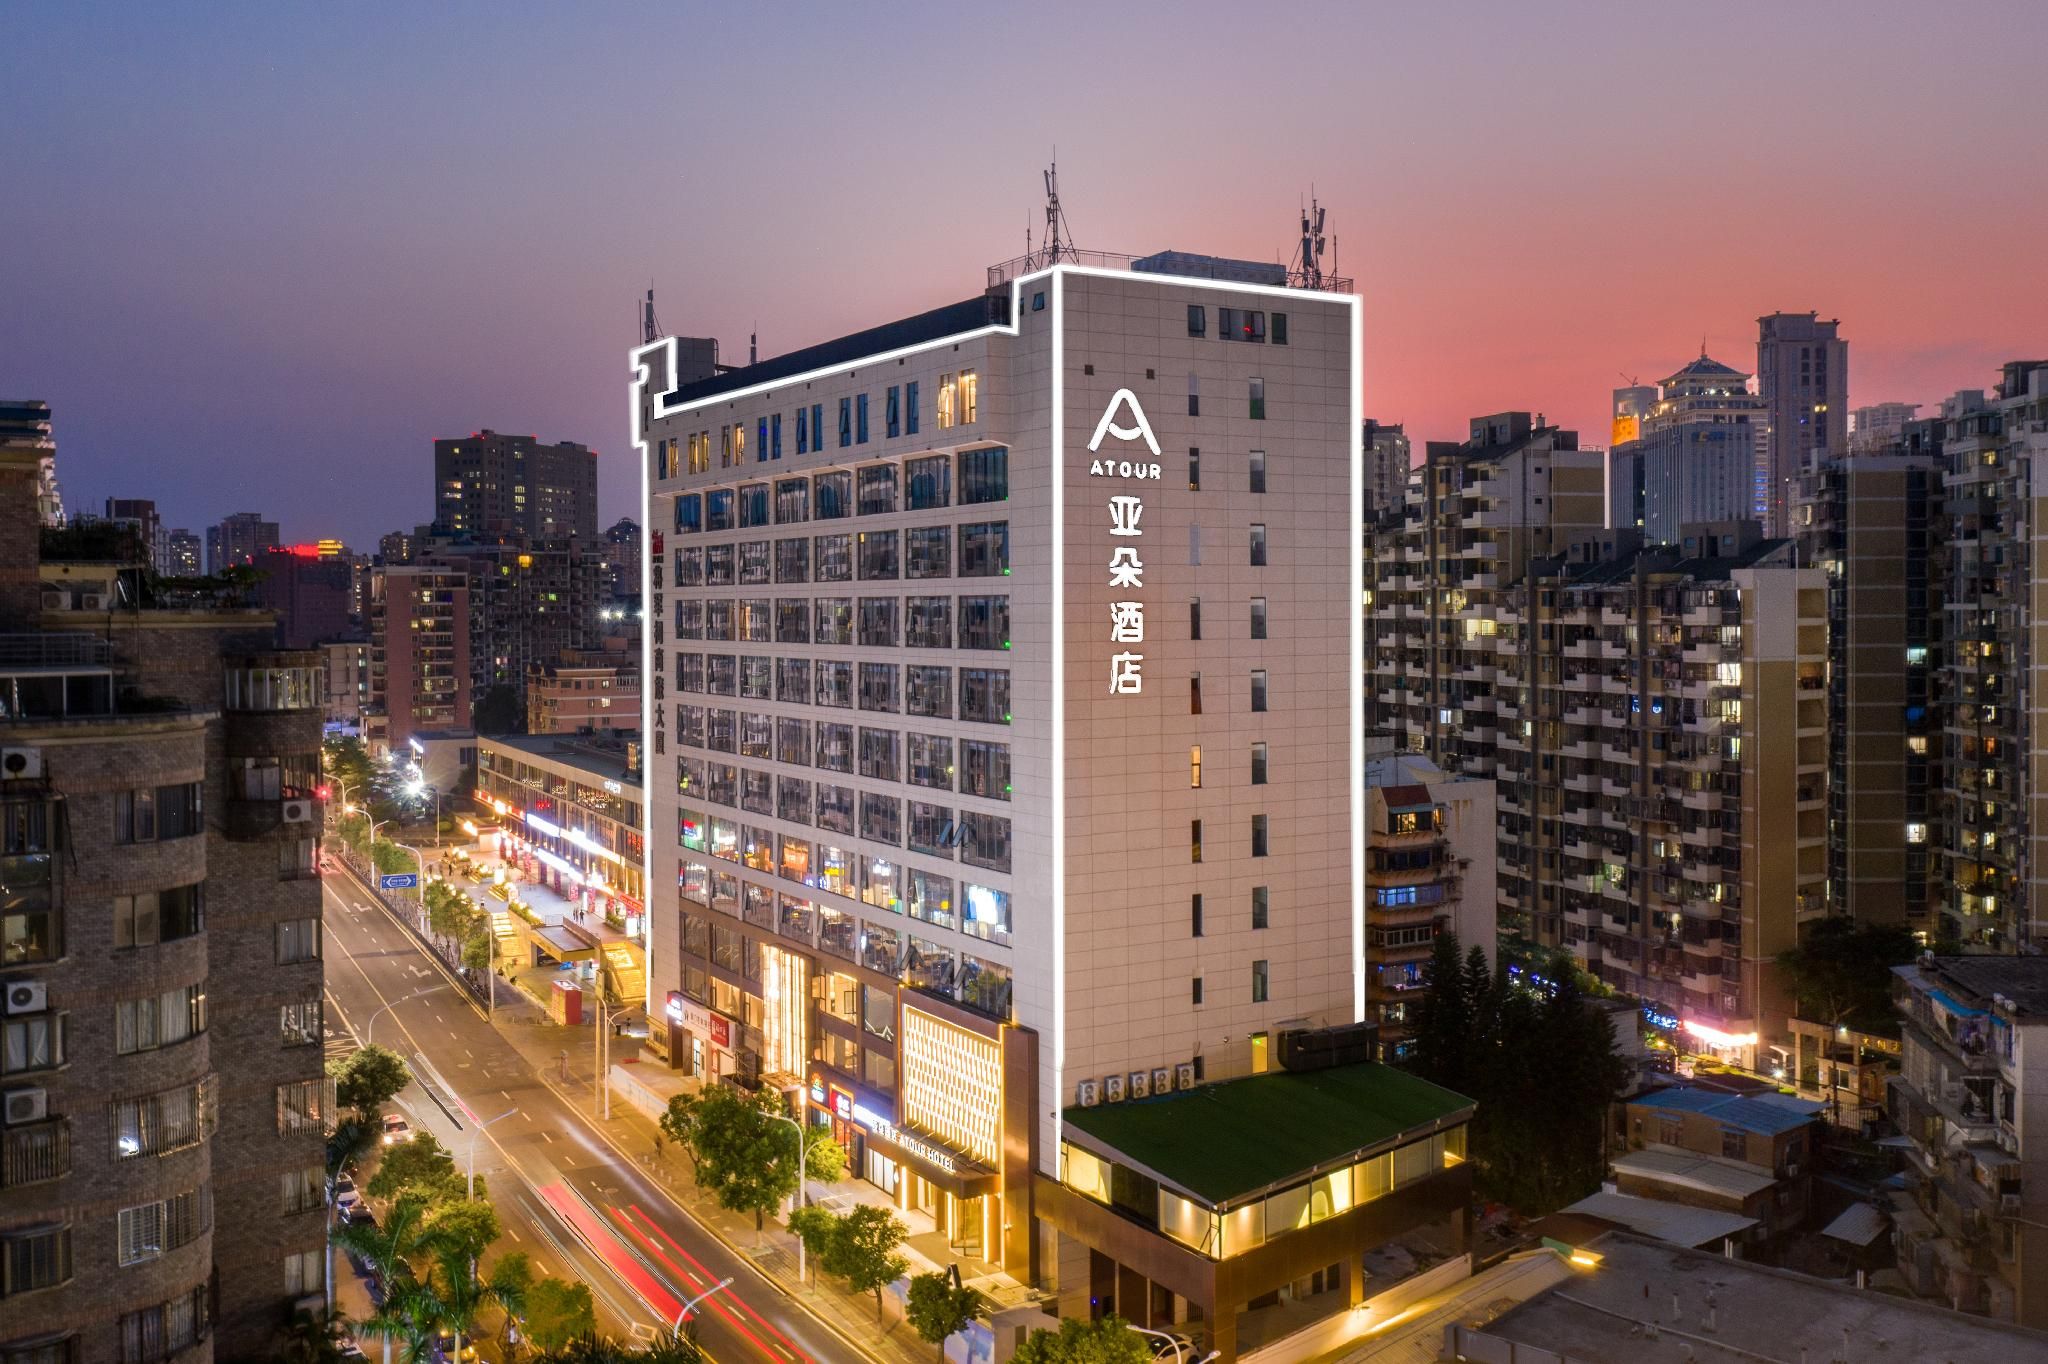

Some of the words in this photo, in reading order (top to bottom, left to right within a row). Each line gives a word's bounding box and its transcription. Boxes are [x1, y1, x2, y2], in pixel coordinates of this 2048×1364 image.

[1090, 459, 1161, 480] ATOUR
[1109, 495, 1144, 695] 亚朵酒店
[898, 1135, 926, 1158] ATOUR
[927, 1149, 955, 1172] HOTEL
